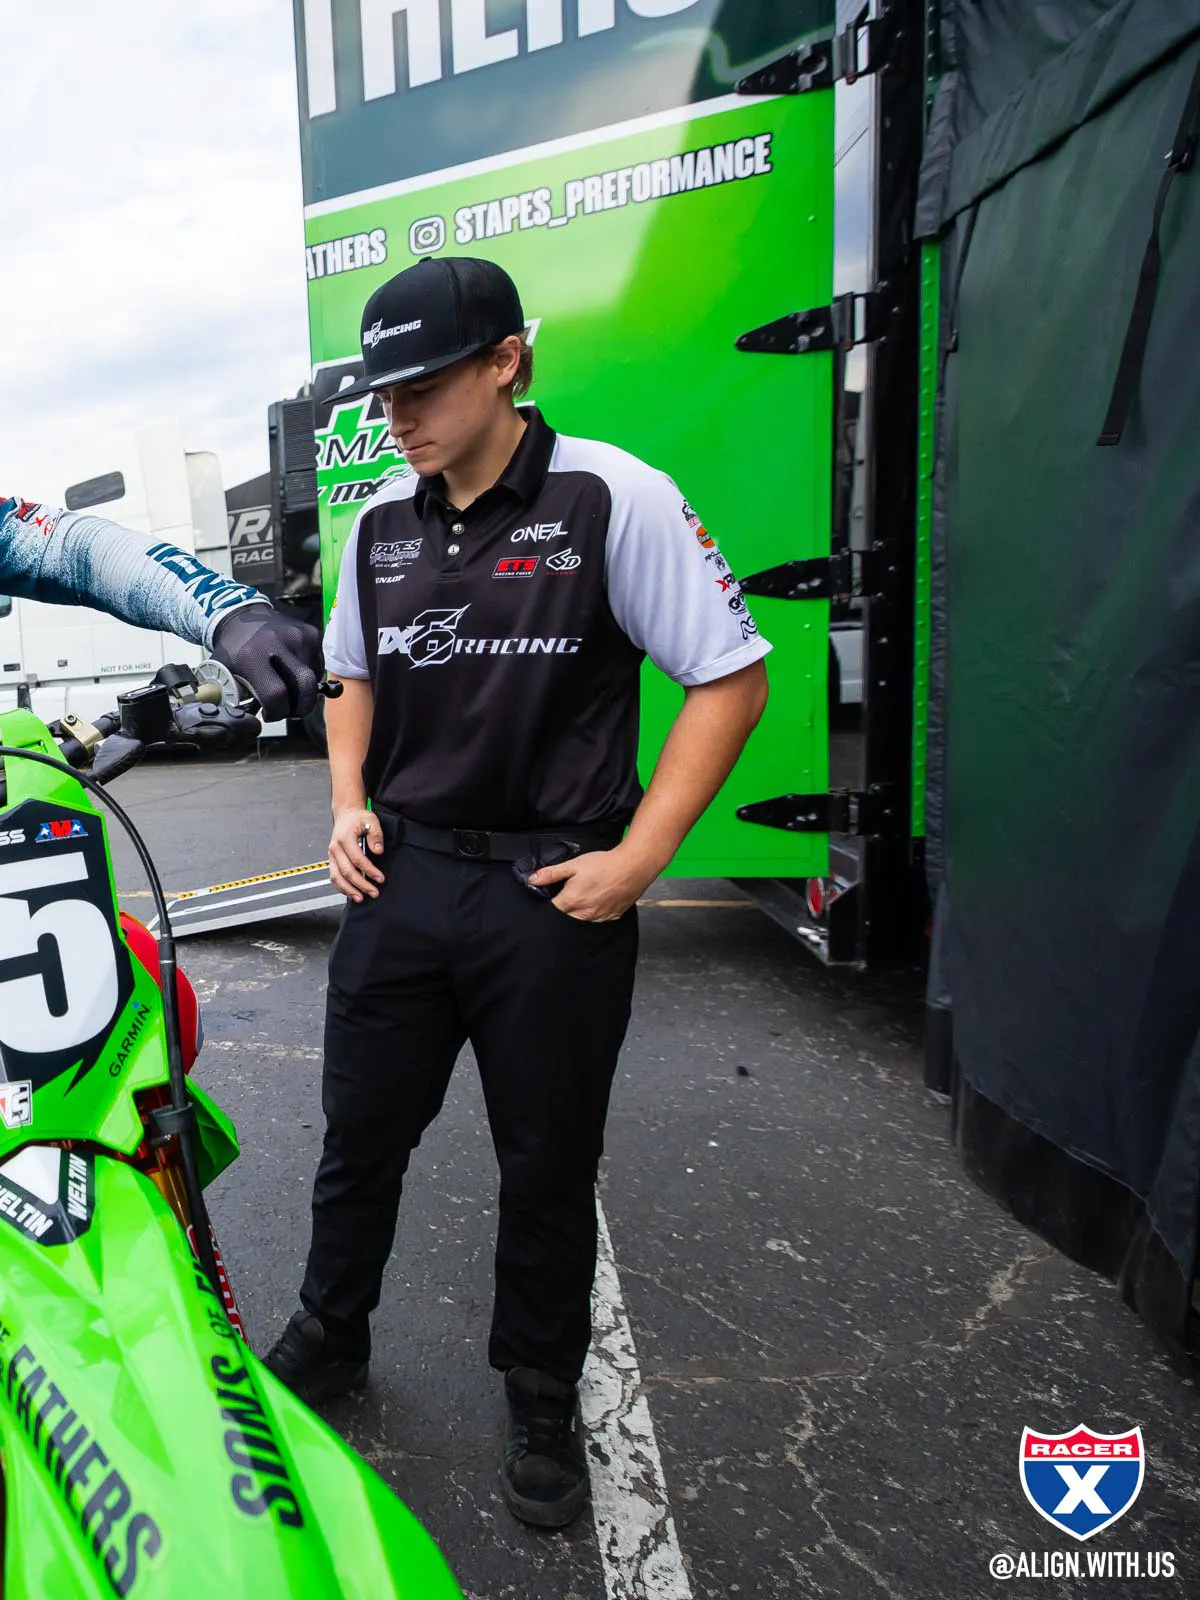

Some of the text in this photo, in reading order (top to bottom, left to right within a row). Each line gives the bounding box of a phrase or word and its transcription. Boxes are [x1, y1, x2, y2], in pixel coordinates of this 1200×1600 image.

[454, 133, 773, 245] STAPES_PREFORMANCE
[379, 320, 422, 339] RACING
[454, 636, 583, 654] RACING
[101, 665, 116, 674] NOT
[118, 664, 133, 672] FOR
[34, 819, 89, 843] AMA
[109, 1003, 150, 1077] GARMIN
[67, 1152, 87, 1221] WELTIN
[7, 1343, 164, 1600] FATHERS
